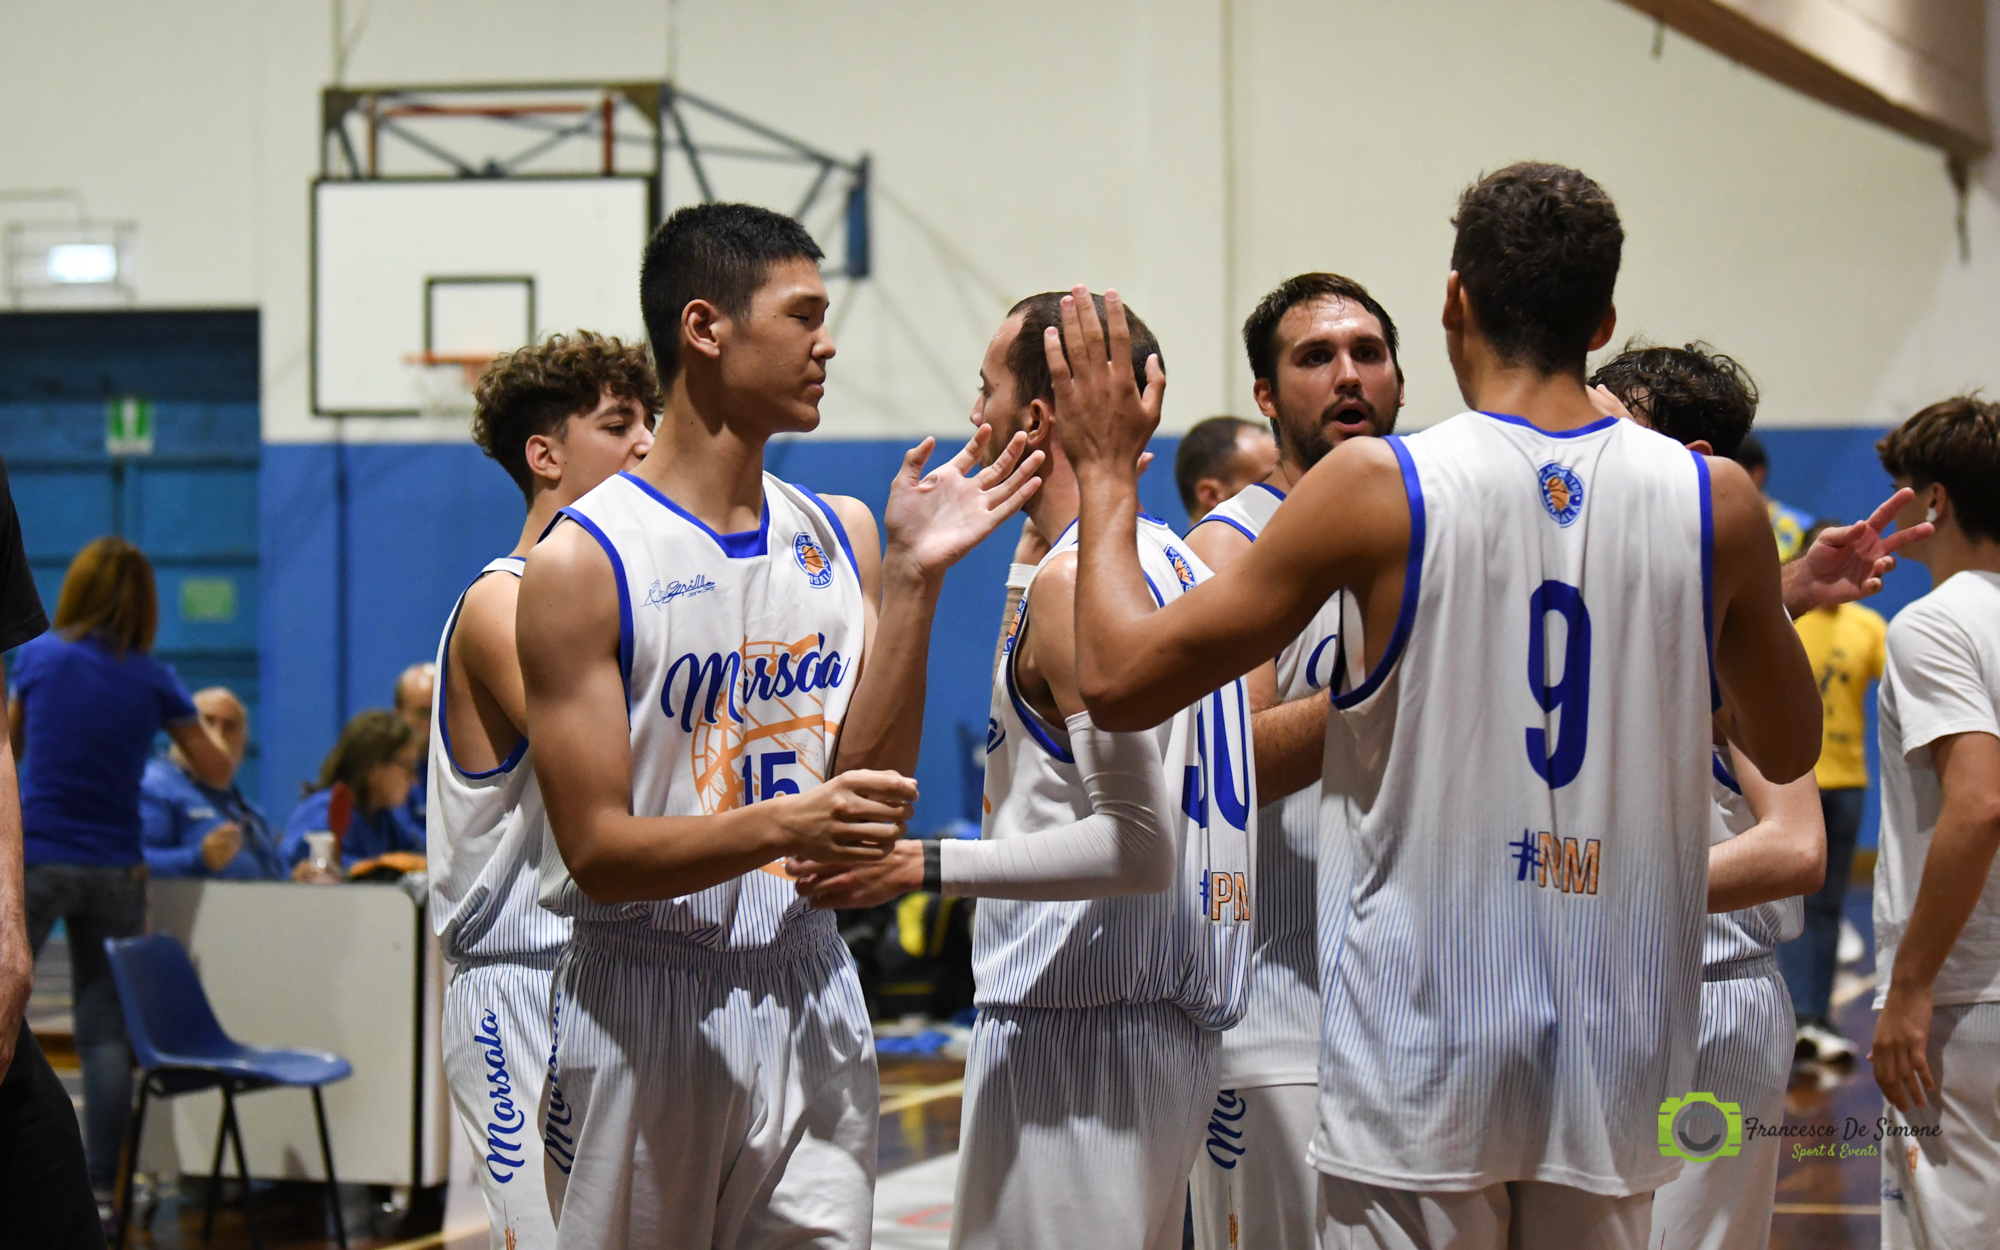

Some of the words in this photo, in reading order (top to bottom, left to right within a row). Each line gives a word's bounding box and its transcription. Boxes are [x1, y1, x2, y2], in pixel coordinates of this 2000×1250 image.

[1526, 580, 1591, 790] 9
[743, 751, 801, 806] 15
[474, 1008, 525, 1184] Marsala
